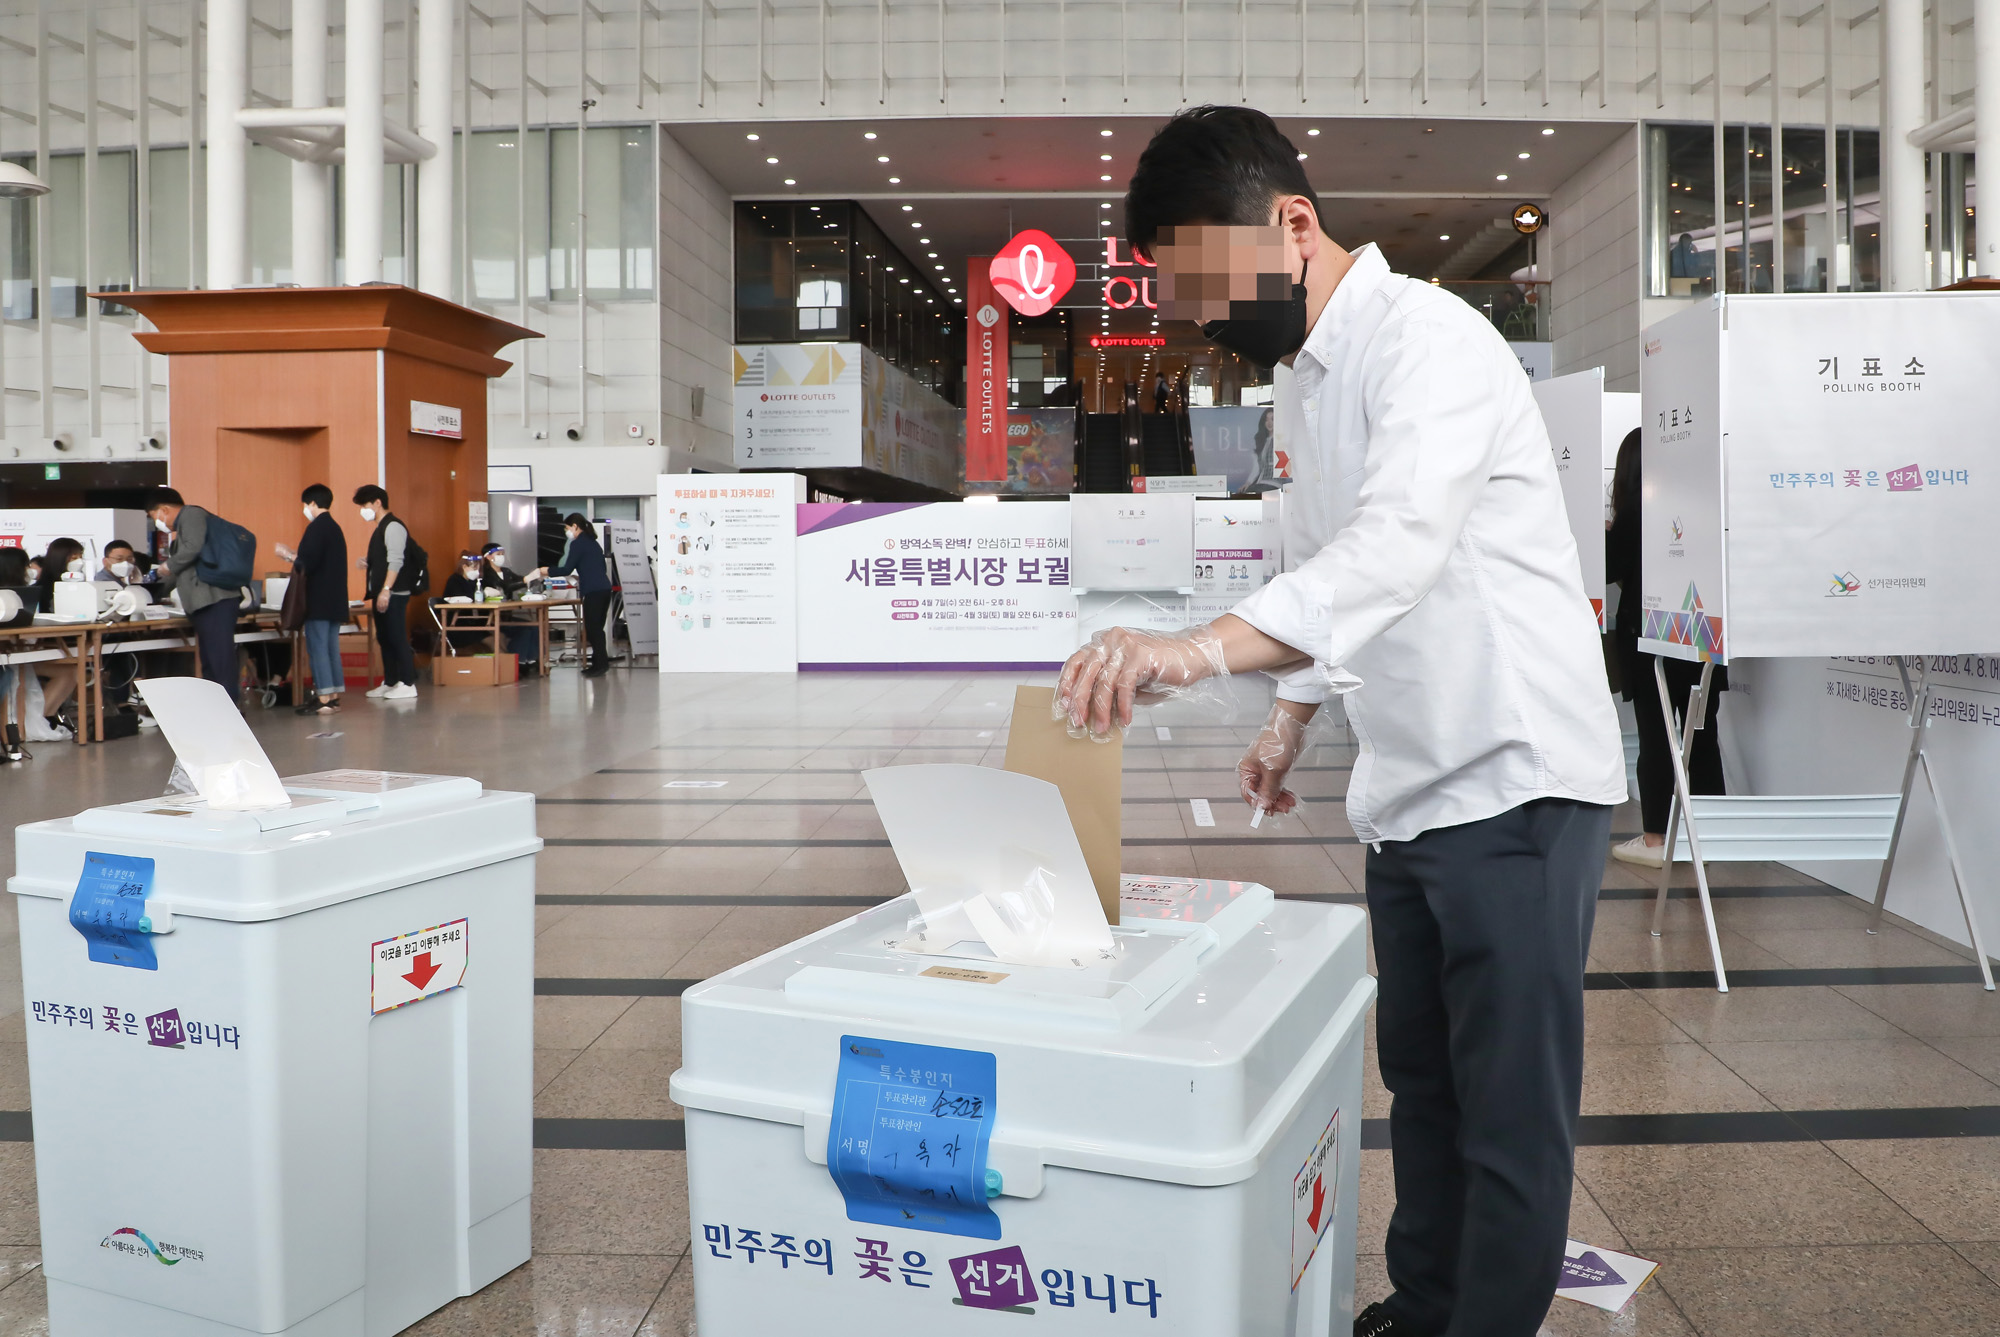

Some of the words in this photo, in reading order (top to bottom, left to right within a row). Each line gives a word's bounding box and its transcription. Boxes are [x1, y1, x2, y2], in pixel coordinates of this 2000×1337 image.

[1131, 338, 1166, 346] OUTLETS
[982, 332, 993, 376] LOTTE
[1823, 383, 1875, 393] POLLING
[1880, 382, 1922, 392] BOOTH
[746, 408, 753, 419] 4
[982, 379, 993, 434] OUTLETS
[746, 428, 753, 439] 3
[1007, 424, 1029, 436] EGO
[1660, 433, 1676, 444] POLLING
[1676, 431, 1691, 441] BOOTH
[747, 447, 753, 458] 2
[1769, 471, 1835, 488] 민주주의
[1842, 469, 1880, 487] 꽃은
[674, 489, 707, 499] 투표하실
[900, 538, 943, 550] 방역소독
[945, 538, 971, 550] 완벽!
[977, 538, 1021, 550] 안심하고
[1024, 538, 1070, 549] 투표하세
[845, 557, 1008, 587] 서울특별시장
[1867, 577, 1926, 589] 선거관리위원회
[921, 599, 933, 607] 4월
[935, 599, 957, 607] 7일(수)
[959, 599, 972, 607] 오전
[1006, 599, 1018, 607] 8시
[921, 612, 933, 620] 4월
[935, 612, 958, 620] 2일(금)
[977, 611, 1001, 620] 3일(토)
[1002, 611, 1016, 620] 매일
[1017, 611, 1031, 620] 오전
[1065, 611, 1077, 619] 6시
[1836, 681, 1861, 702] 자세한
[1863, 686, 1888, 708] 사항은
[380, 945, 402, 961] 이곳을
[404, 941, 418, 956] 잡고
[420, 935, 440, 950] 이동해
[441, 929, 461, 944] 주세요
[31, 1000, 94, 1030] 민주주의
[102, 1005, 139, 1036] 꽃은
[879, 1064, 953, 1088] 특수봉인지
[884, 1091, 927, 1107] 투표관리관
[879, 1116, 922, 1133] 투표참관인
[111, 1240, 135, 1254] 아름다운
[137, 1246, 149, 1258] 선거
[159, 1241, 177, 1255] 행복한
[179, 1247, 204, 1261] 대한민국
[702, 1222, 834, 1276] 민주주의
[853, 1236, 933, 1289] 꽃은
